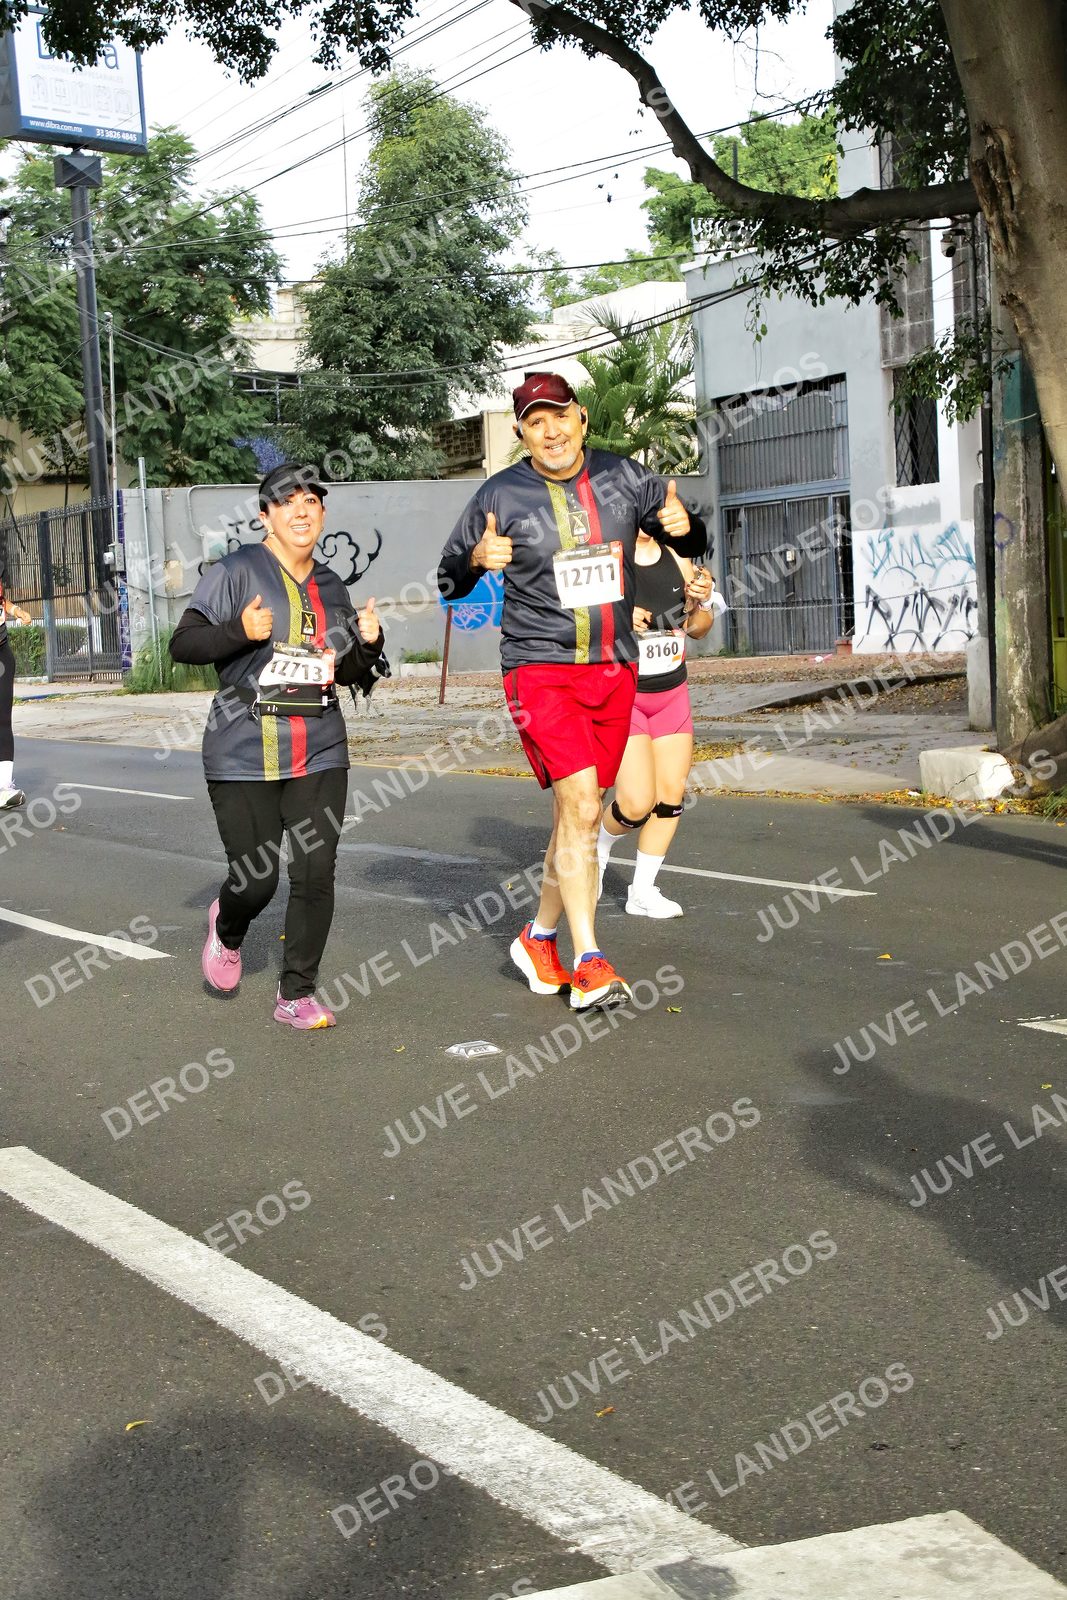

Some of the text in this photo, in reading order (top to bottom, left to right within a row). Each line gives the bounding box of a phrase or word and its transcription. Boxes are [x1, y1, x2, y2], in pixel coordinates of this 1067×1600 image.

[29, 119, 83, 133] www.dibra.com.mx
[96, 128, 137, 142] 33 3826 4845
[559, 562, 615, 588] 12711
[646, 641, 679, 659] 8160
[270, 659, 323, 682] 12713
